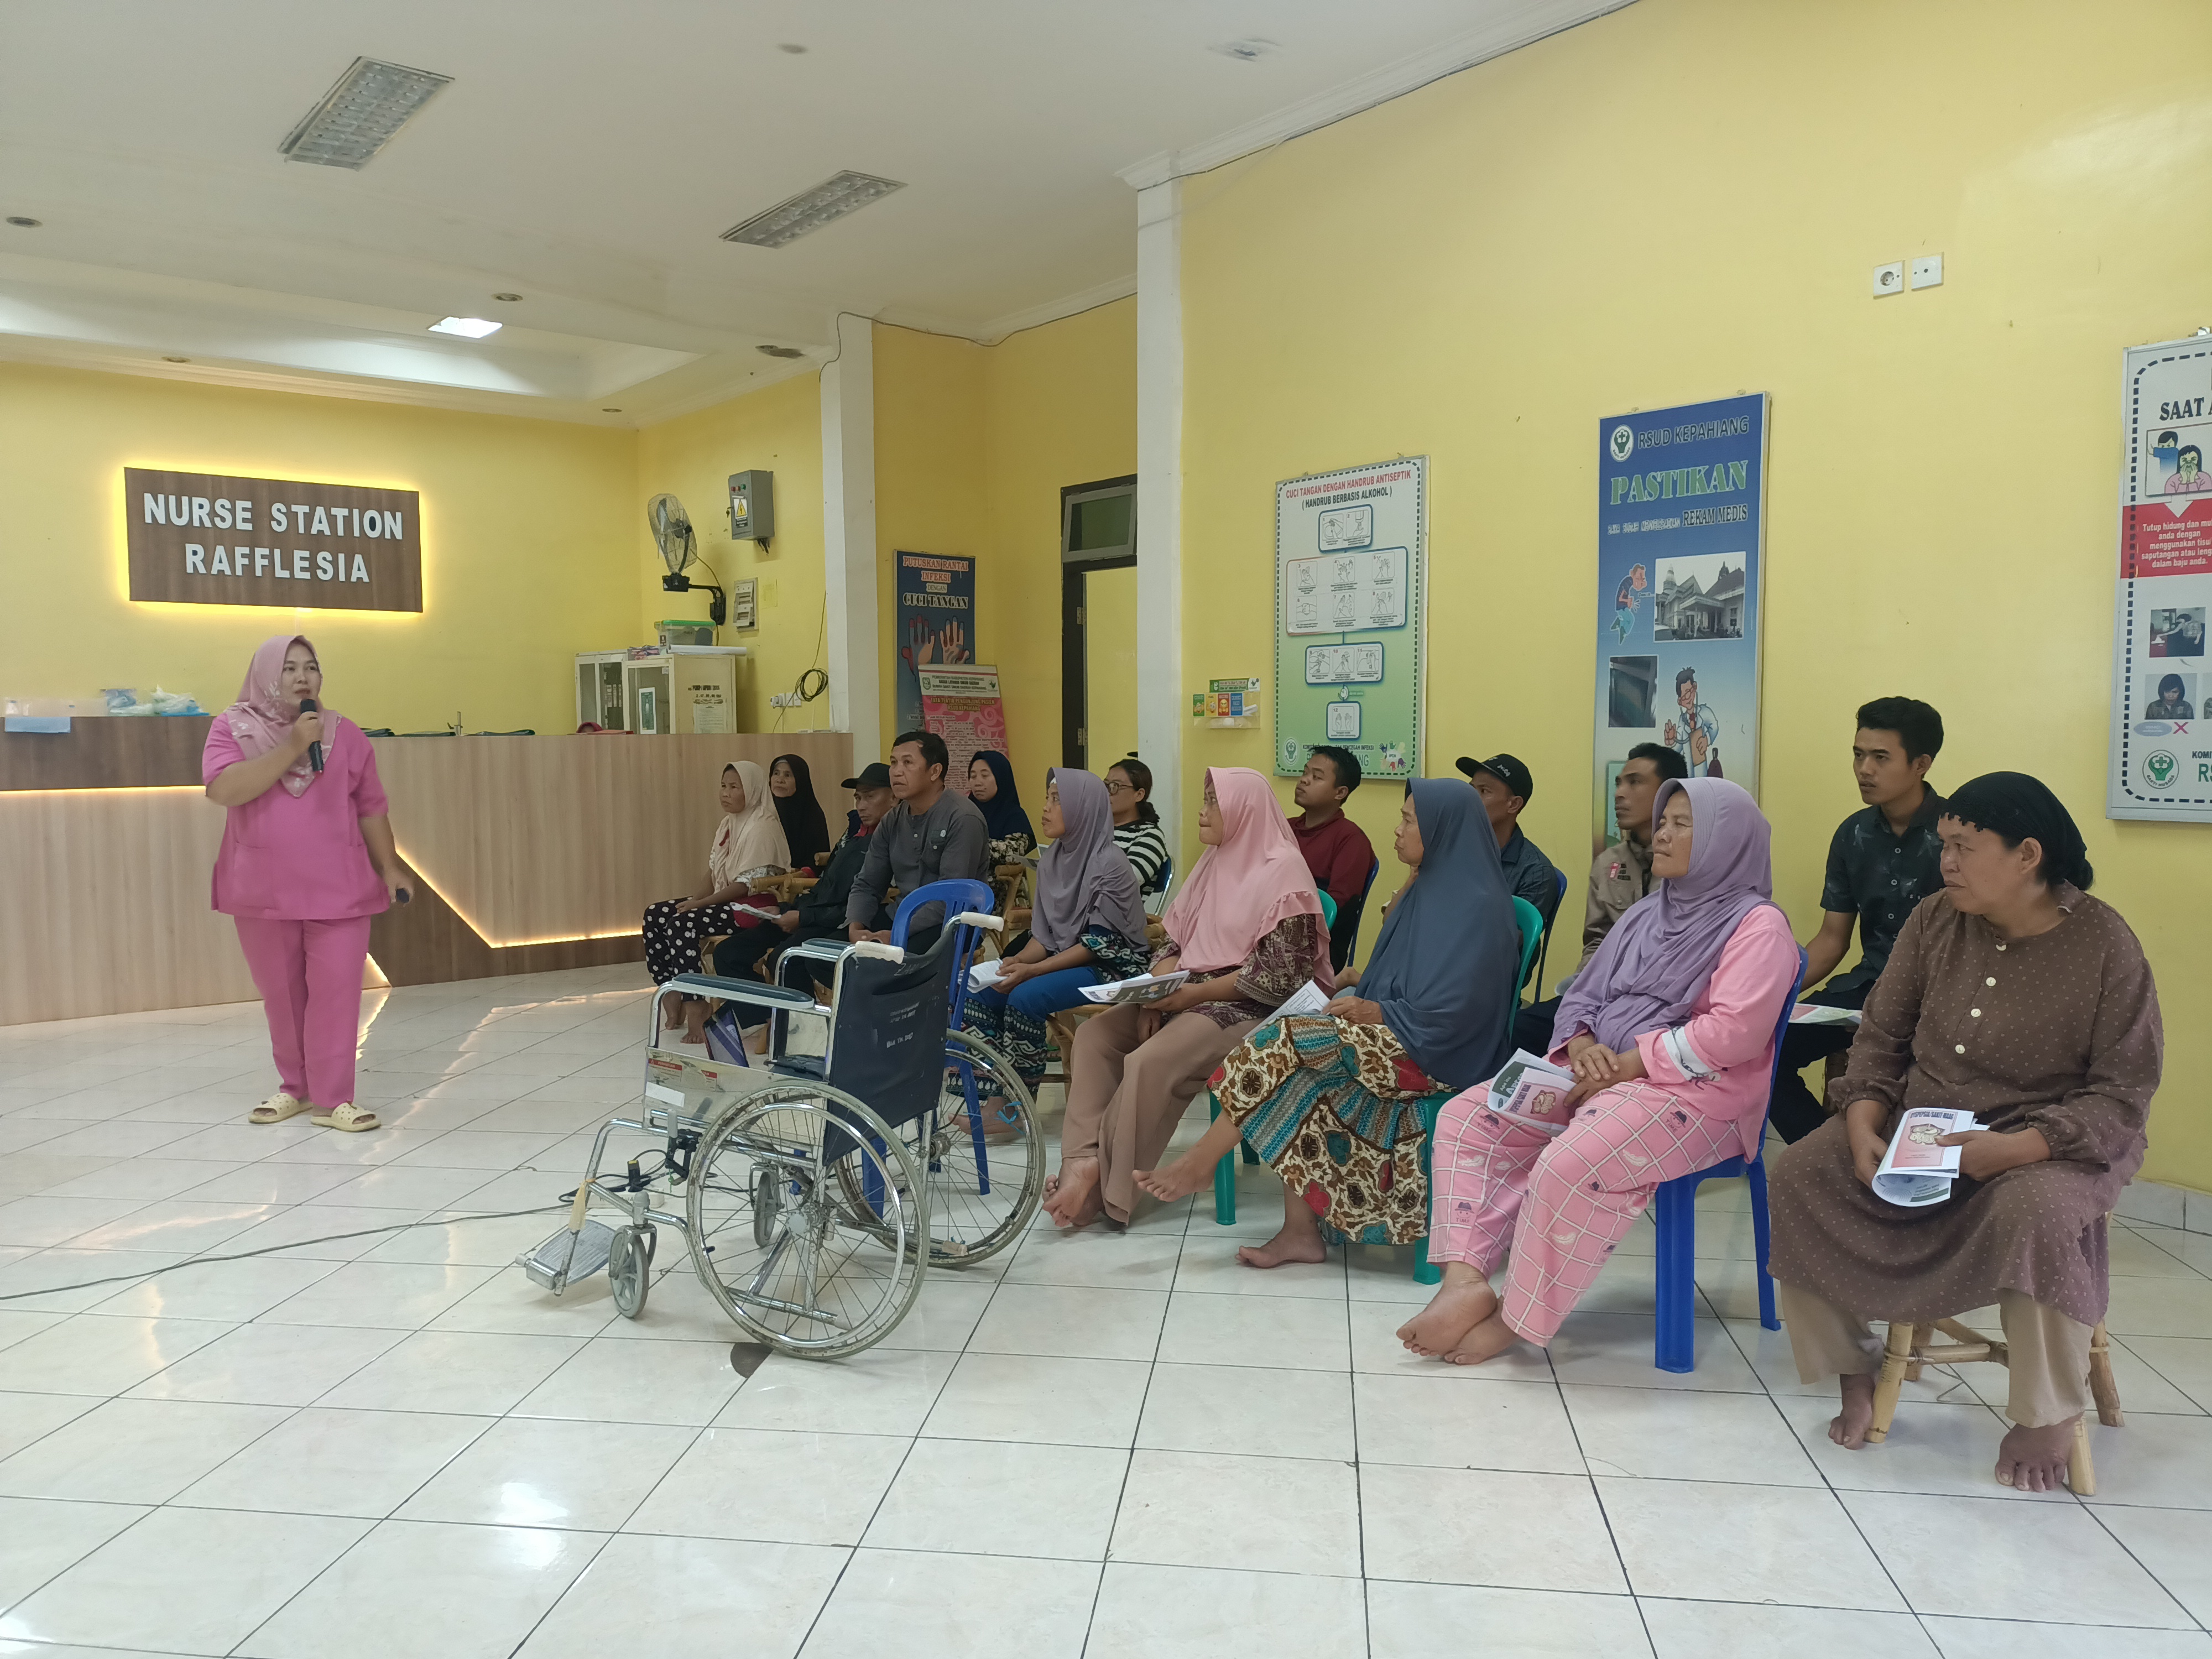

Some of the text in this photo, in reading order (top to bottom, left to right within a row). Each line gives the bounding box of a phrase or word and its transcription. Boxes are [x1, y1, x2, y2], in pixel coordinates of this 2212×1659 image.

[2159, 397, 2205, 421] SAAT
[1638, 416, 1749, 448] RSUD KEPAHIANG
[1286, 469, 1411, 499] CUCI TANGAN DENGAN HANDRUB ANTISEPTIK
[1610, 460, 1749, 504] PASTIKAN
[1332, 491, 1360, 504] BERBASIS
[143, 493, 403, 540] NURSE STATION
[1682, 507, 1715, 526] REKAM
[1718, 504, 1747, 524] MEDIS
[2142, 523, 2161, 532] Tutup
[2163, 521, 2185, 530] hidung
[2187, 520, 2199, 528] dan
[2158, 530, 2201, 540] anda dengan
[2150, 539, 2195, 550] menggunakan
[185, 543, 369, 582] RAFFLESIA
[904, 556, 968, 571] PUTUSKAN RANTAI
[2141, 551, 2179, 561] saputangan
[2152, 560, 2172, 568] dalam
[2173, 558, 2188, 567] baju
[922, 571, 951, 583] INFEKSI
[903, 593, 968, 609] CUCI TANGAN
[1665, 1119, 1678, 1133] TIME
